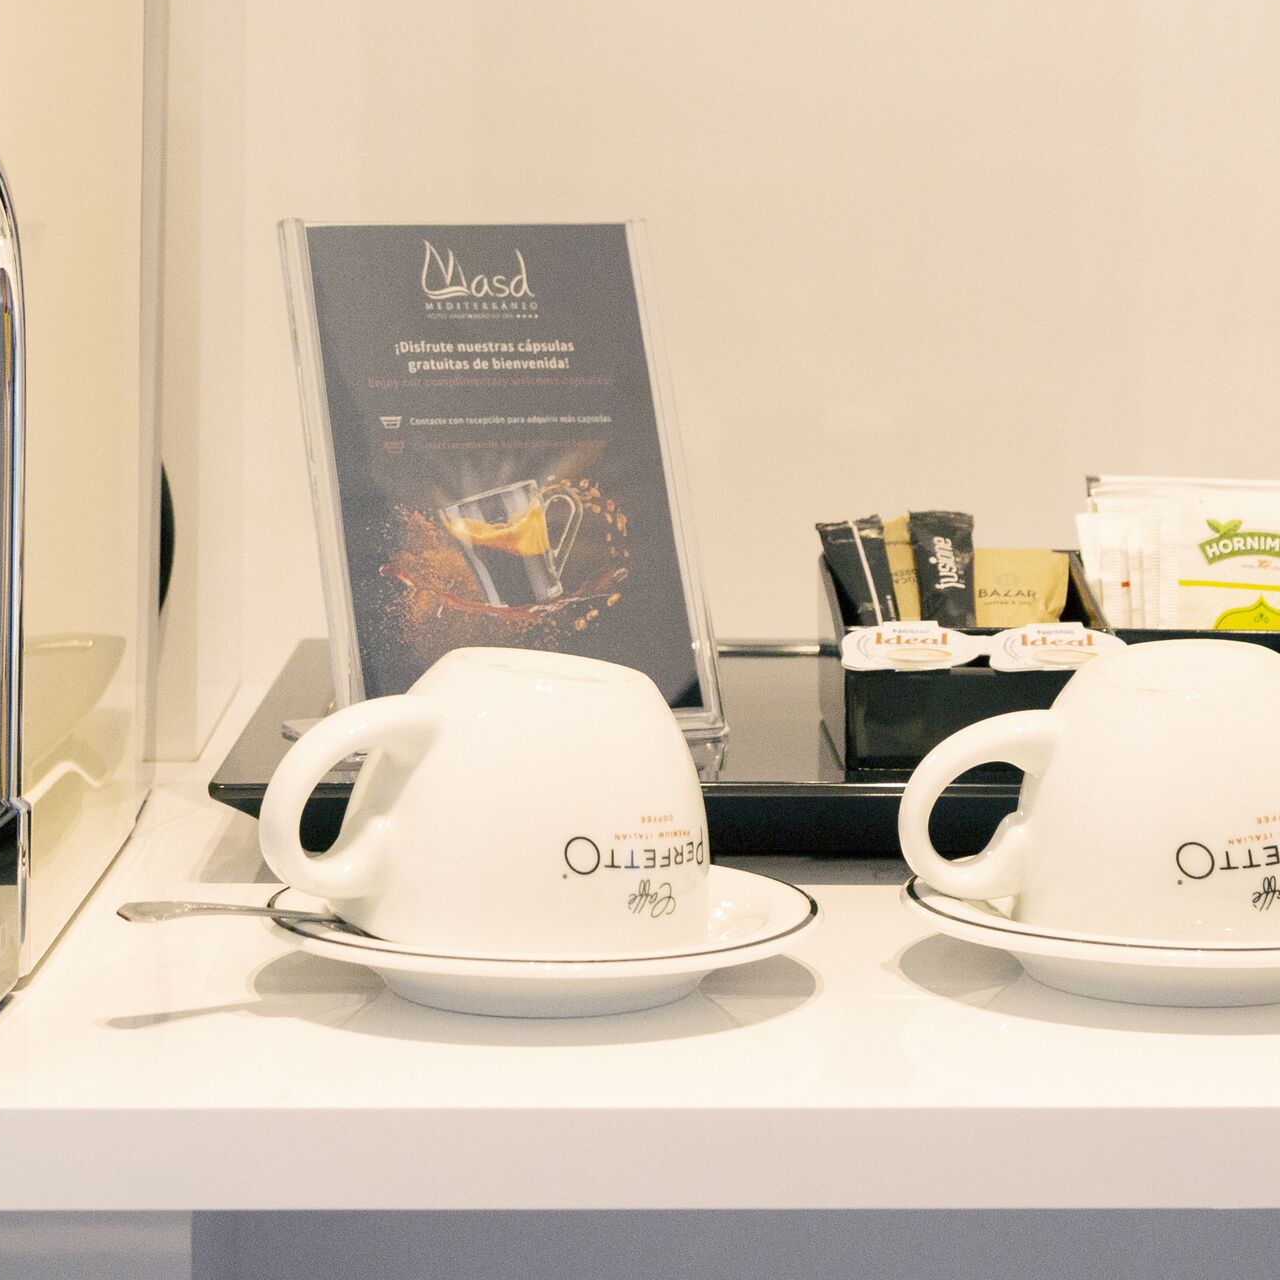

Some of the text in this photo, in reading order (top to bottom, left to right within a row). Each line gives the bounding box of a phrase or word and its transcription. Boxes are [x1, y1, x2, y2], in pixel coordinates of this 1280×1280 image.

[395, 339, 575, 355] ¡Disfrute nuestras cápsulas
[408, 357, 570, 373] gratuitas de bienvenida!
[978, 588, 1039, 600] BAZAR
[875, 632, 948, 645] Ideal
[1021, 634, 1094, 646] Ideal
[614, 832, 653, 840] ITALIAN
[1228, 831, 1272, 845] ITALIAN
[564, 826, 704, 875] PERFETTO
